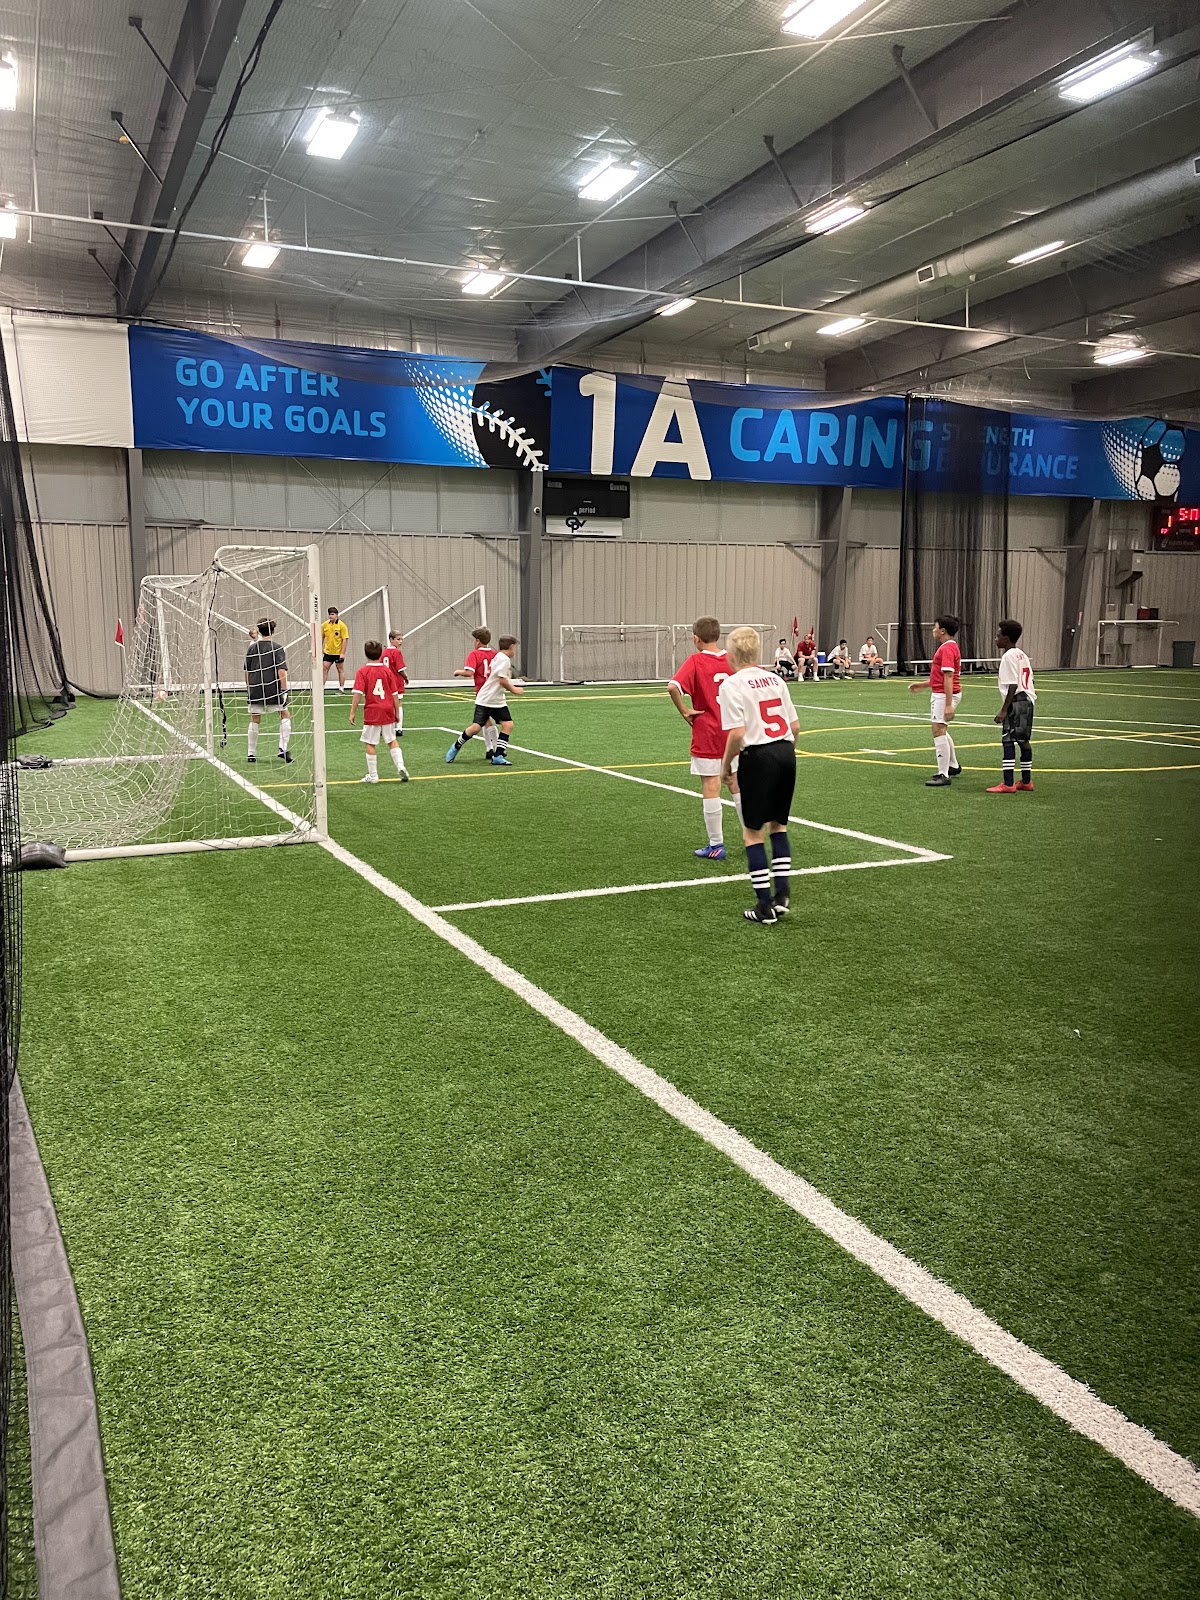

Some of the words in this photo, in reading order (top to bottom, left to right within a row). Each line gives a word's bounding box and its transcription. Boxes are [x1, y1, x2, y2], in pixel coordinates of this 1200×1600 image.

[175, 357, 224, 389] GO
[235, 363, 340, 397] AFTER
[176, 396, 274, 430] YOUR
[284, 405, 387, 438] GOALS
[729, 407, 934, 472] CARING
[578, 506, 596, 515] period
[372, 678, 386, 700] 4
[747, 676, 779, 690] SAINTS
[758, 697, 789, 739] 5
